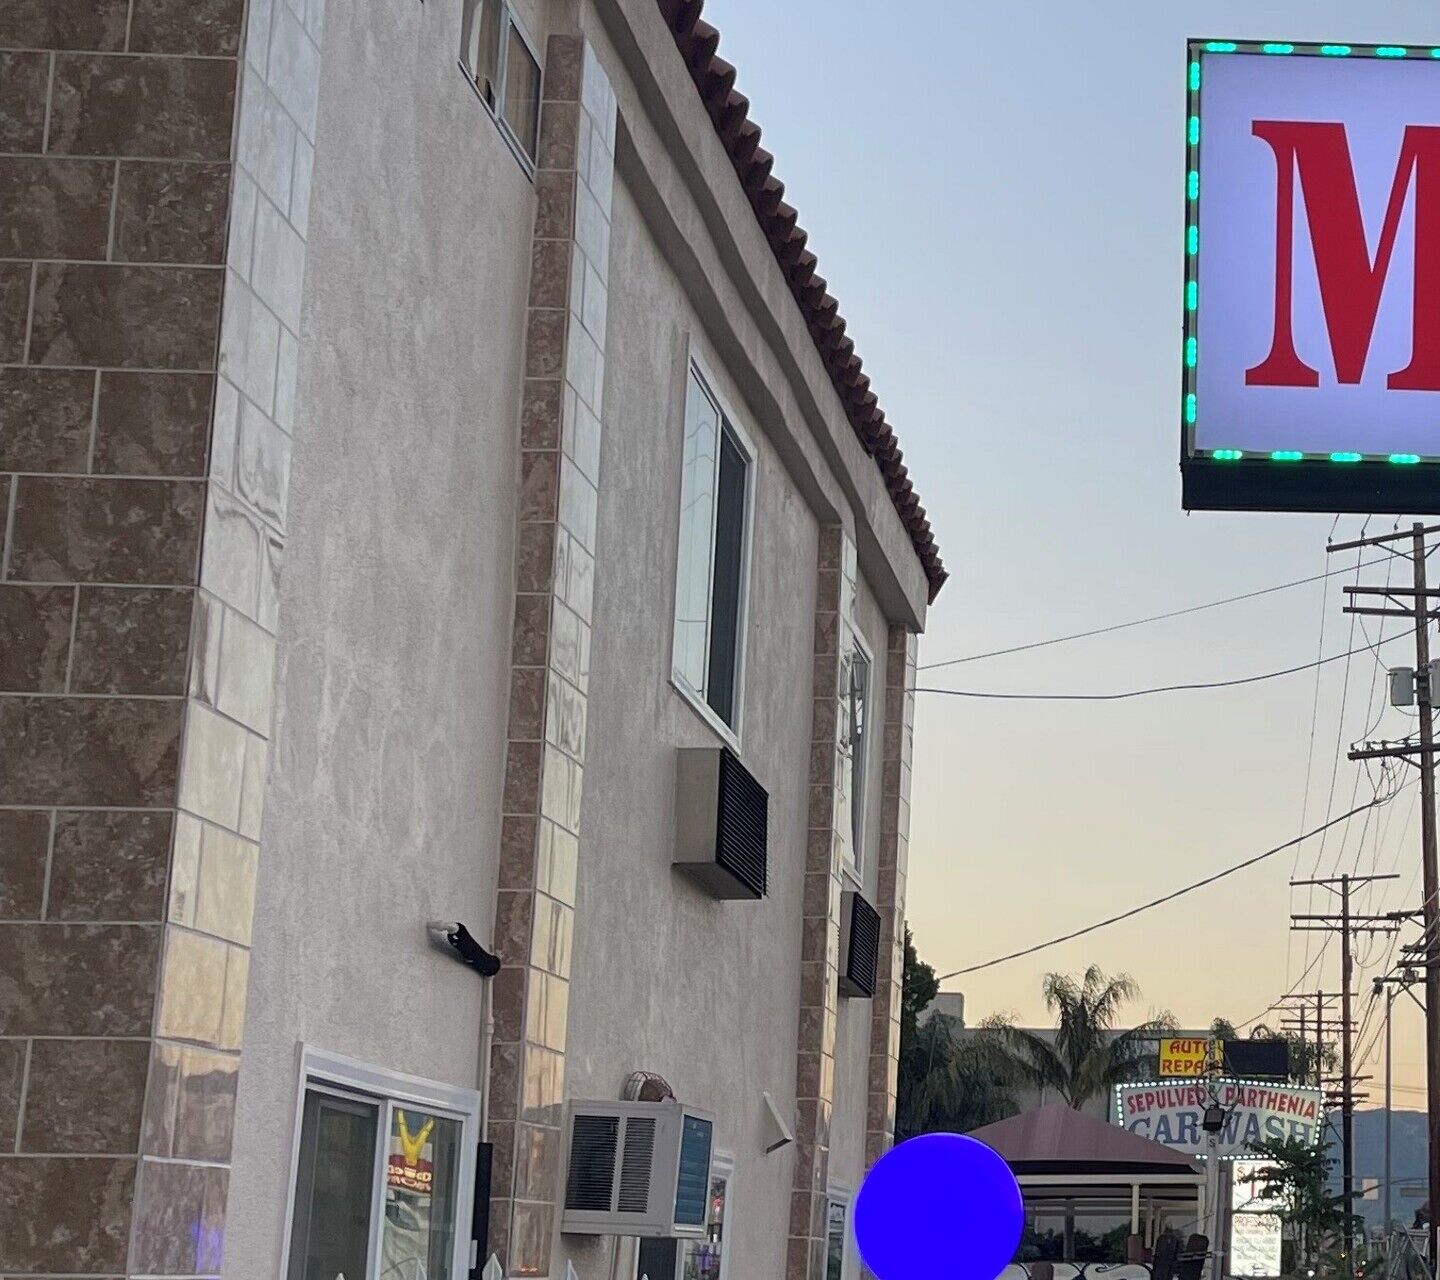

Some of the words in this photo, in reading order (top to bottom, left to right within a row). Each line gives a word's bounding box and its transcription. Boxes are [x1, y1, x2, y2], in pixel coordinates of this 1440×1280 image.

[1161, 1059, 1208, 1074] REPA
[1127, 1087, 1208, 1115] SEPULVED
[1224, 1086, 1316, 1120] PARTHENIA
[1128, 1111, 1201, 1145] CAR
[1218, 1111, 1316, 1148] WASH
